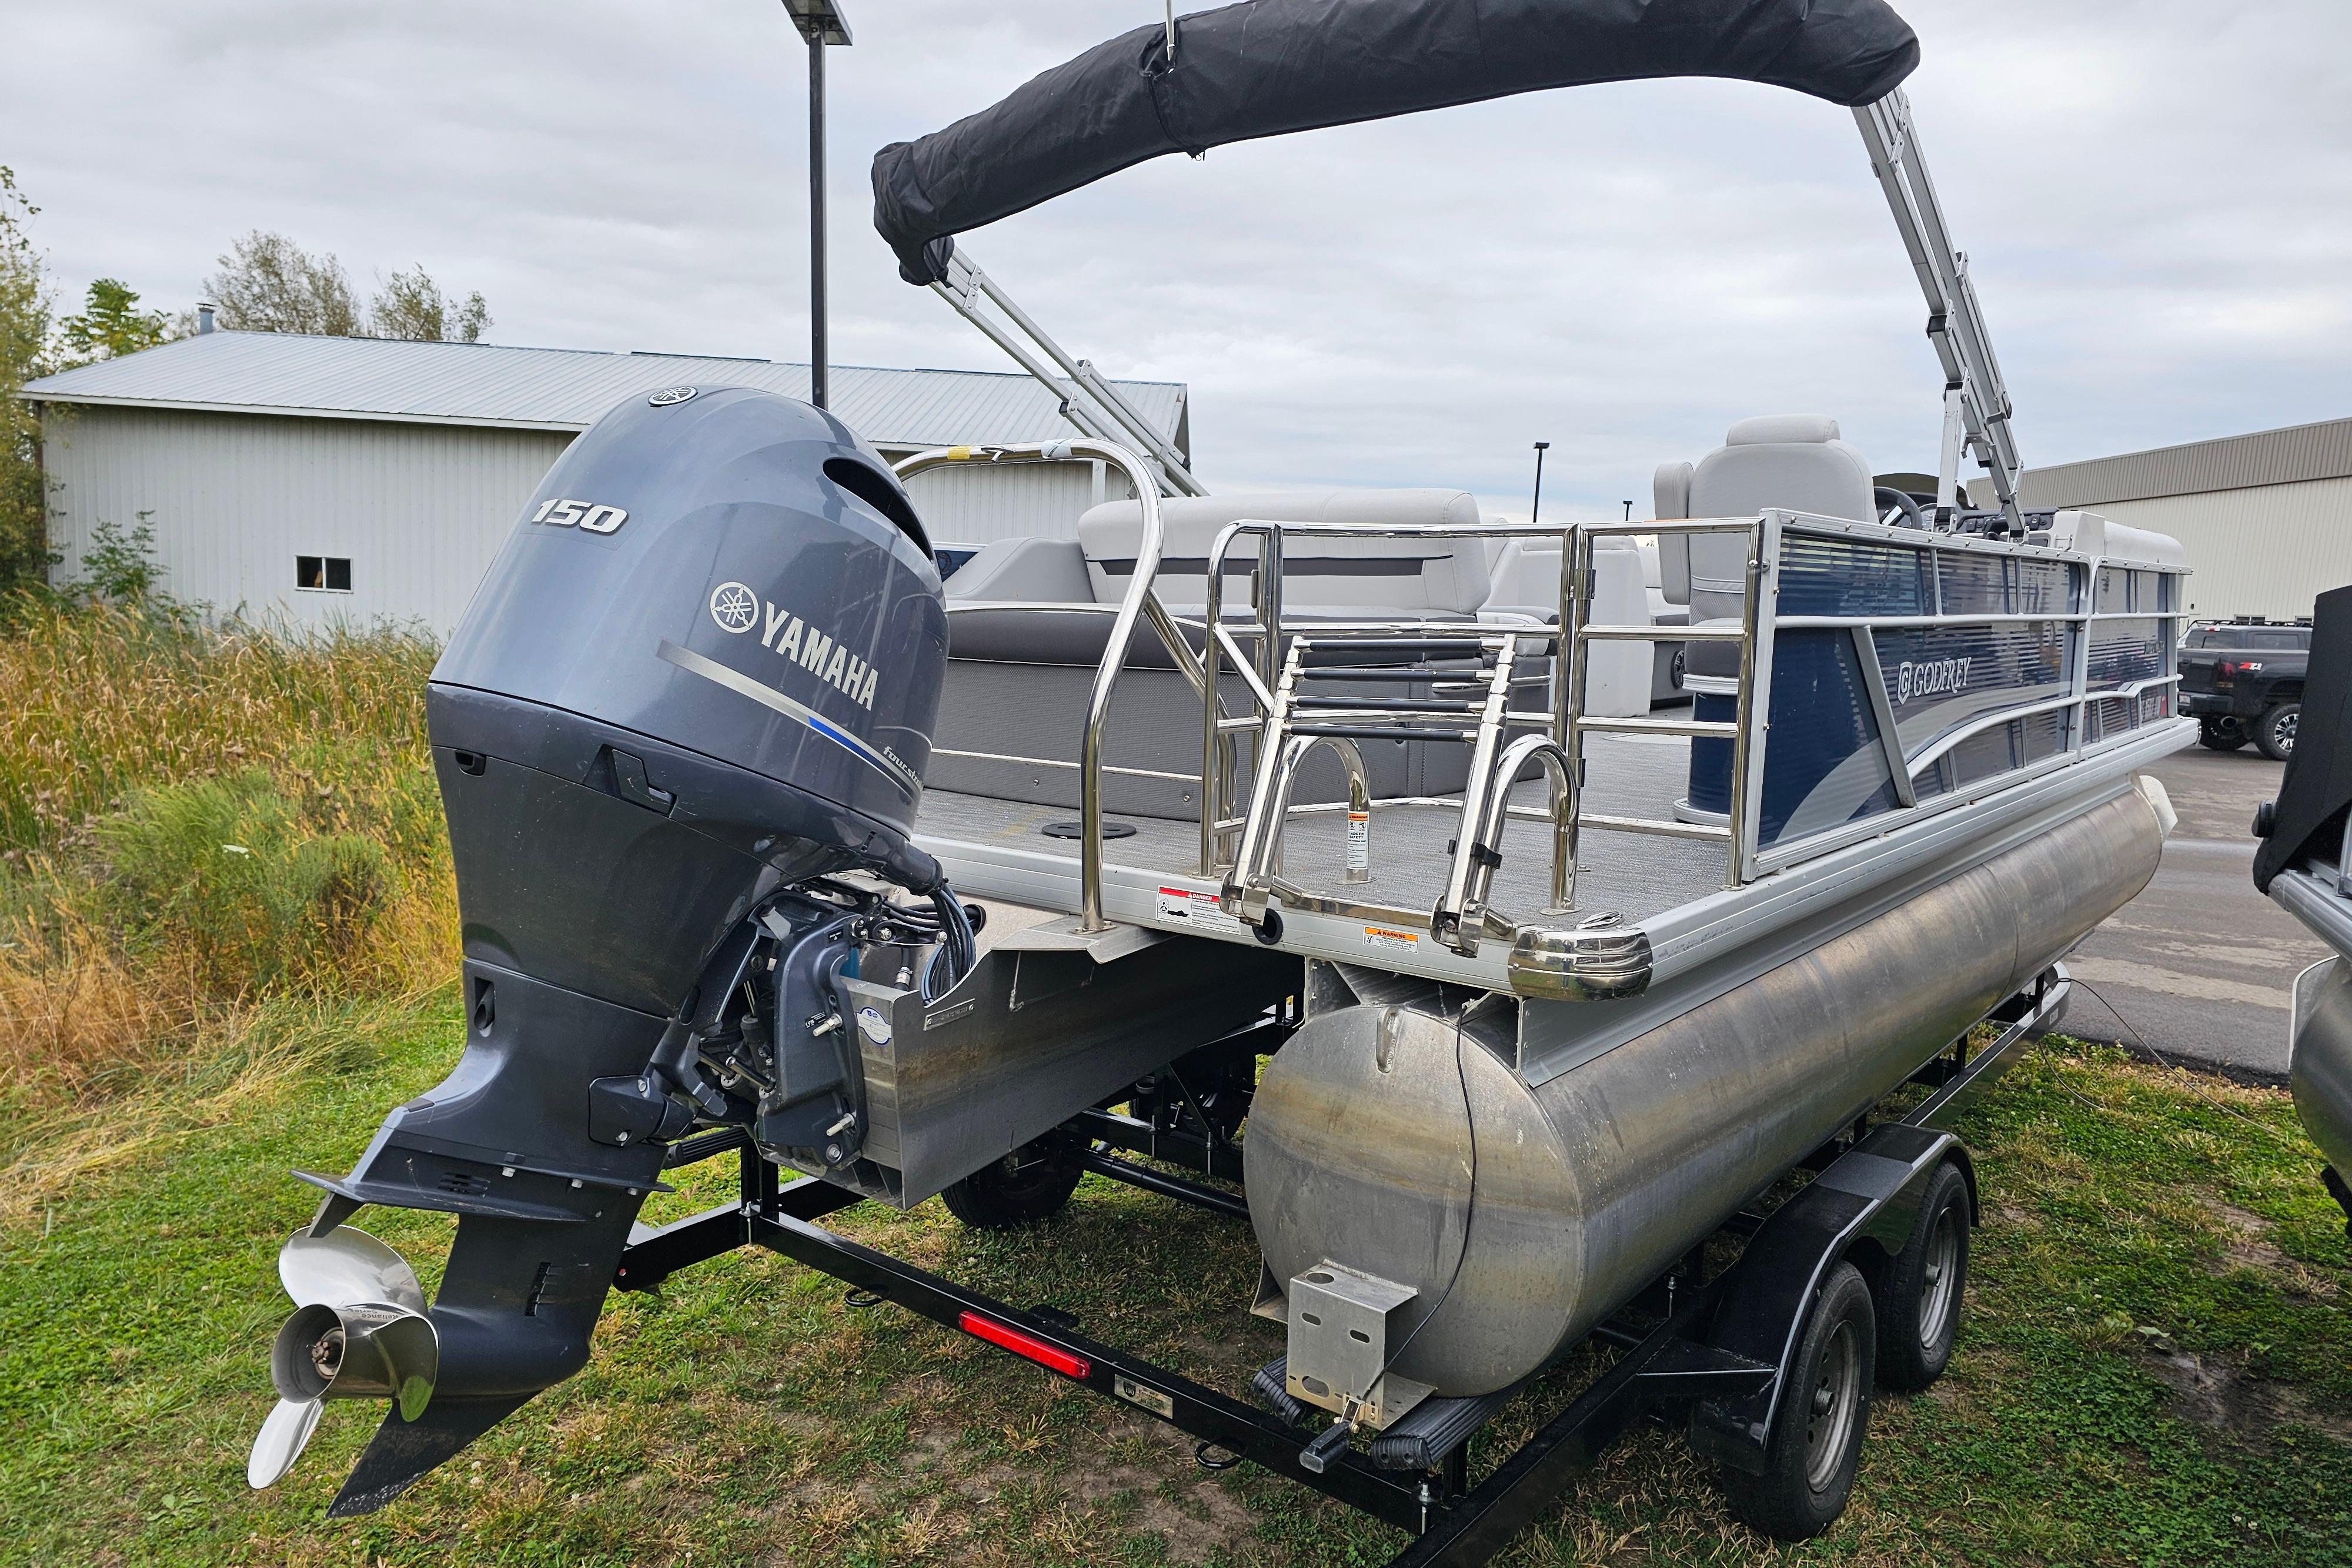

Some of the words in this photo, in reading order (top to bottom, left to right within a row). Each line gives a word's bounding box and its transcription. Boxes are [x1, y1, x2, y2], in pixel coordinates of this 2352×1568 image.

[532, 499, 628, 536] 150
[761, 601, 879, 712] YAMAHA
[1913, 657, 1972, 697] GODFREY
[883, 745, 923, 792] fourstro
